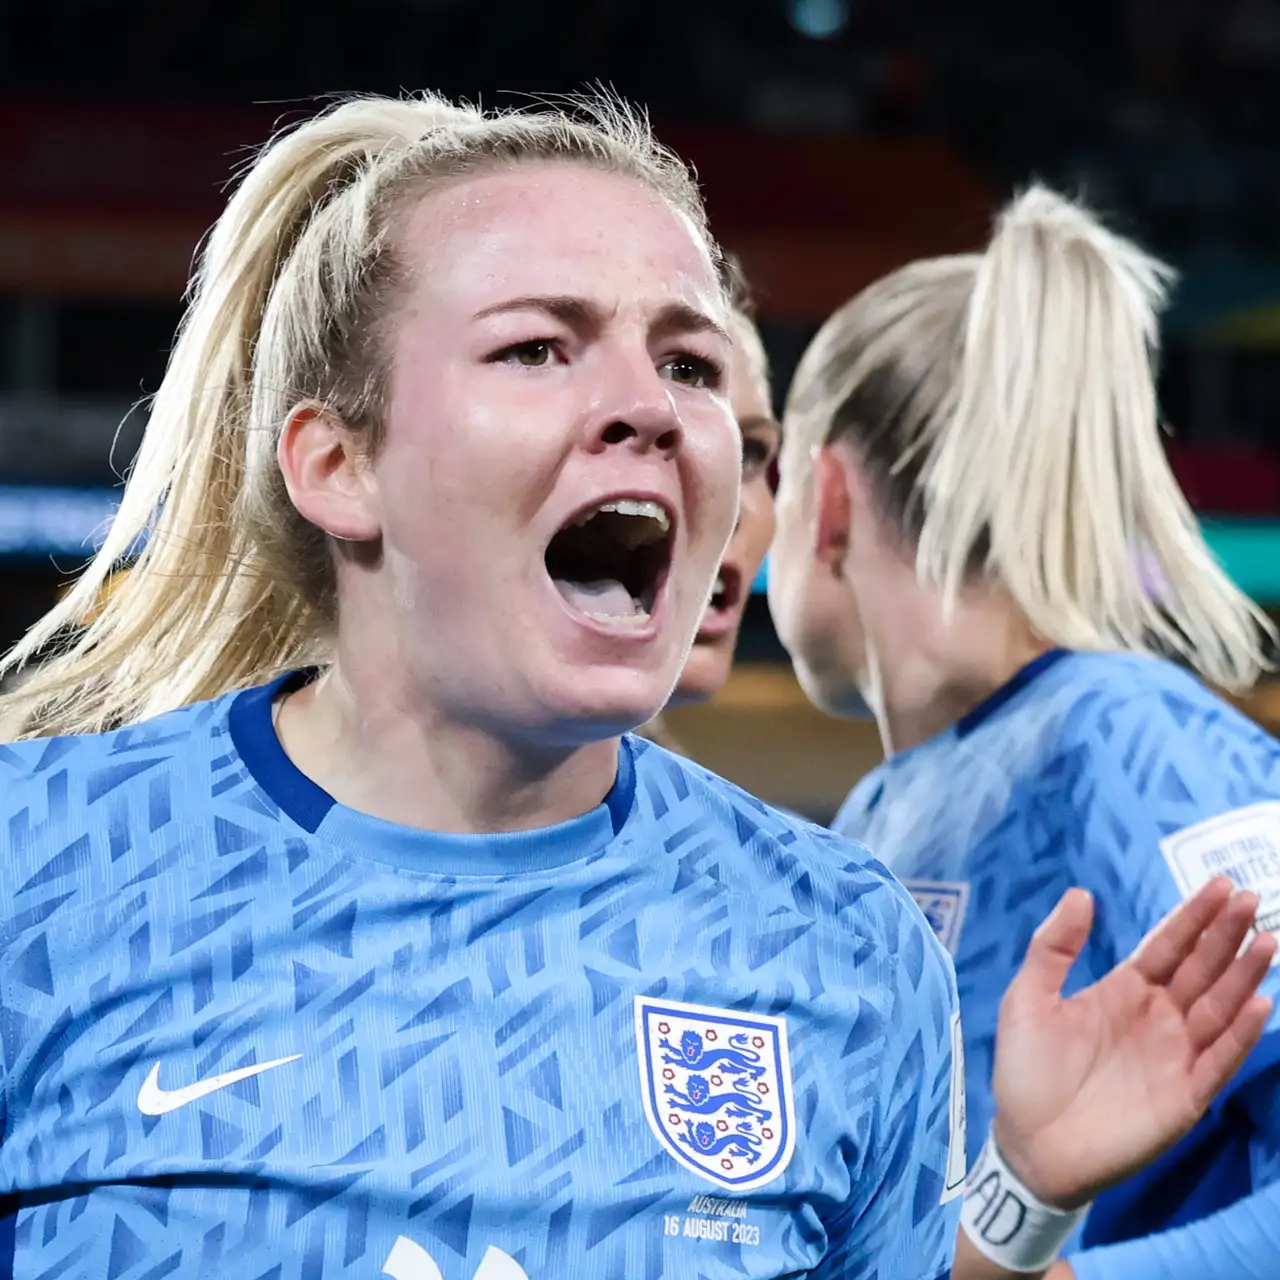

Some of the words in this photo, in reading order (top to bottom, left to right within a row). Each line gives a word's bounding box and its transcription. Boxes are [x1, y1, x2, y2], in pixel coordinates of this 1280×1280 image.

[688, 1196, 747, 1218] AUSTRALIA
[964, 1155, 1027, 1246] AD
[664, 1215, 679, 1236] 16
[684, 1220, 729, 1241] AUGUST
[732, 1223, 760, 1245] 2023
